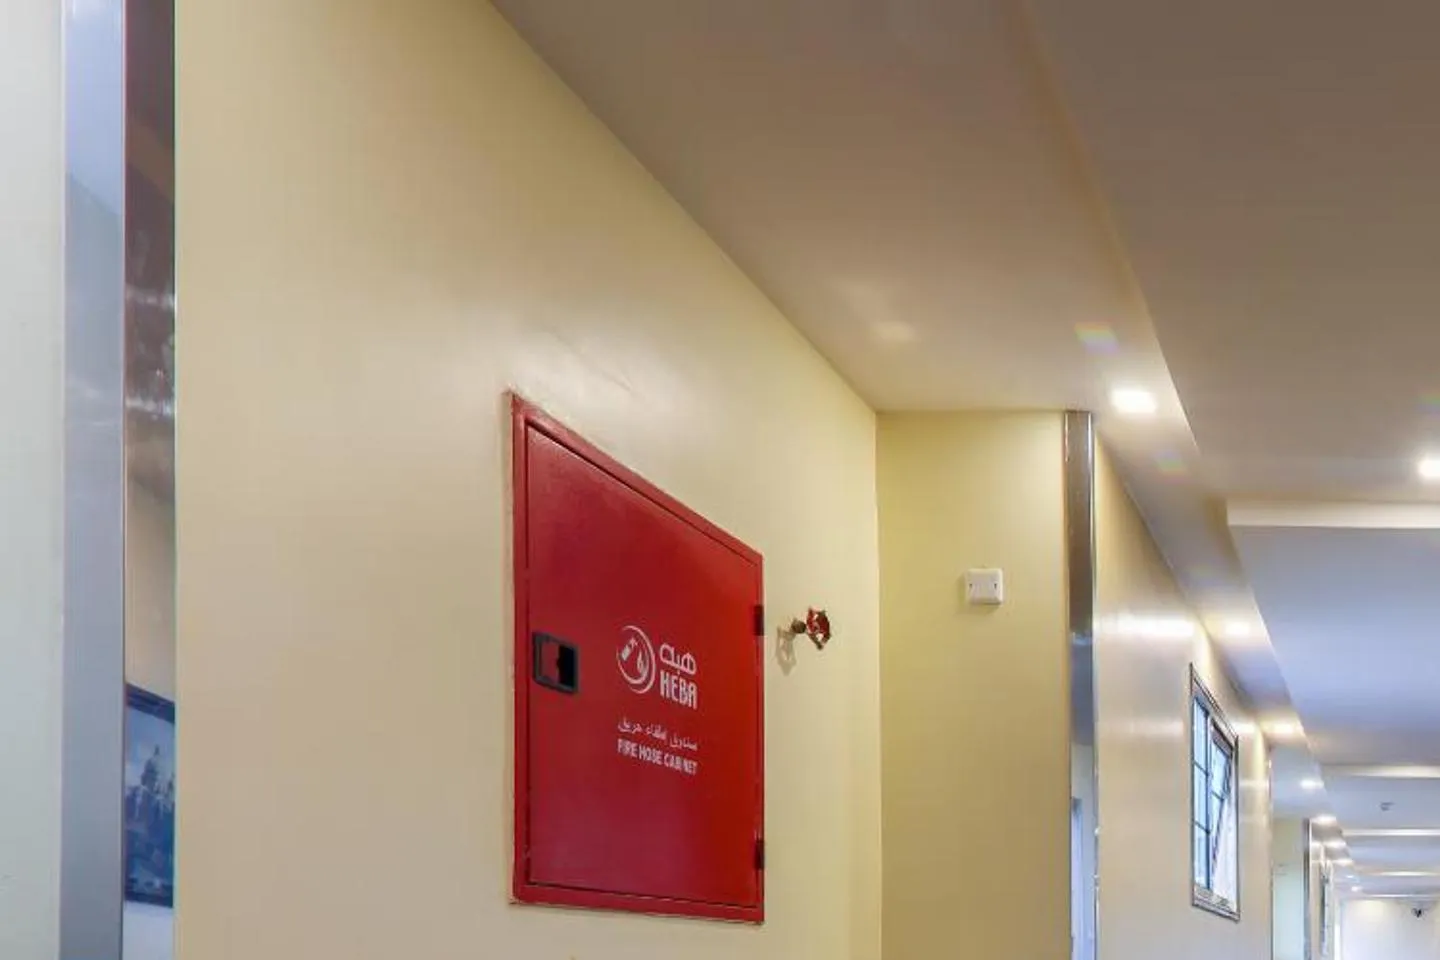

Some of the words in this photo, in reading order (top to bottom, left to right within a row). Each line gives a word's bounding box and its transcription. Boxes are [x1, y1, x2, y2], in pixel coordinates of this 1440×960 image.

[660, 669, 698, 709] HEBA
[617, 738, 638, 758] FIRE
[639, 744, 663, 766] HOSE
[664, 753, 698, 776] CABINET
